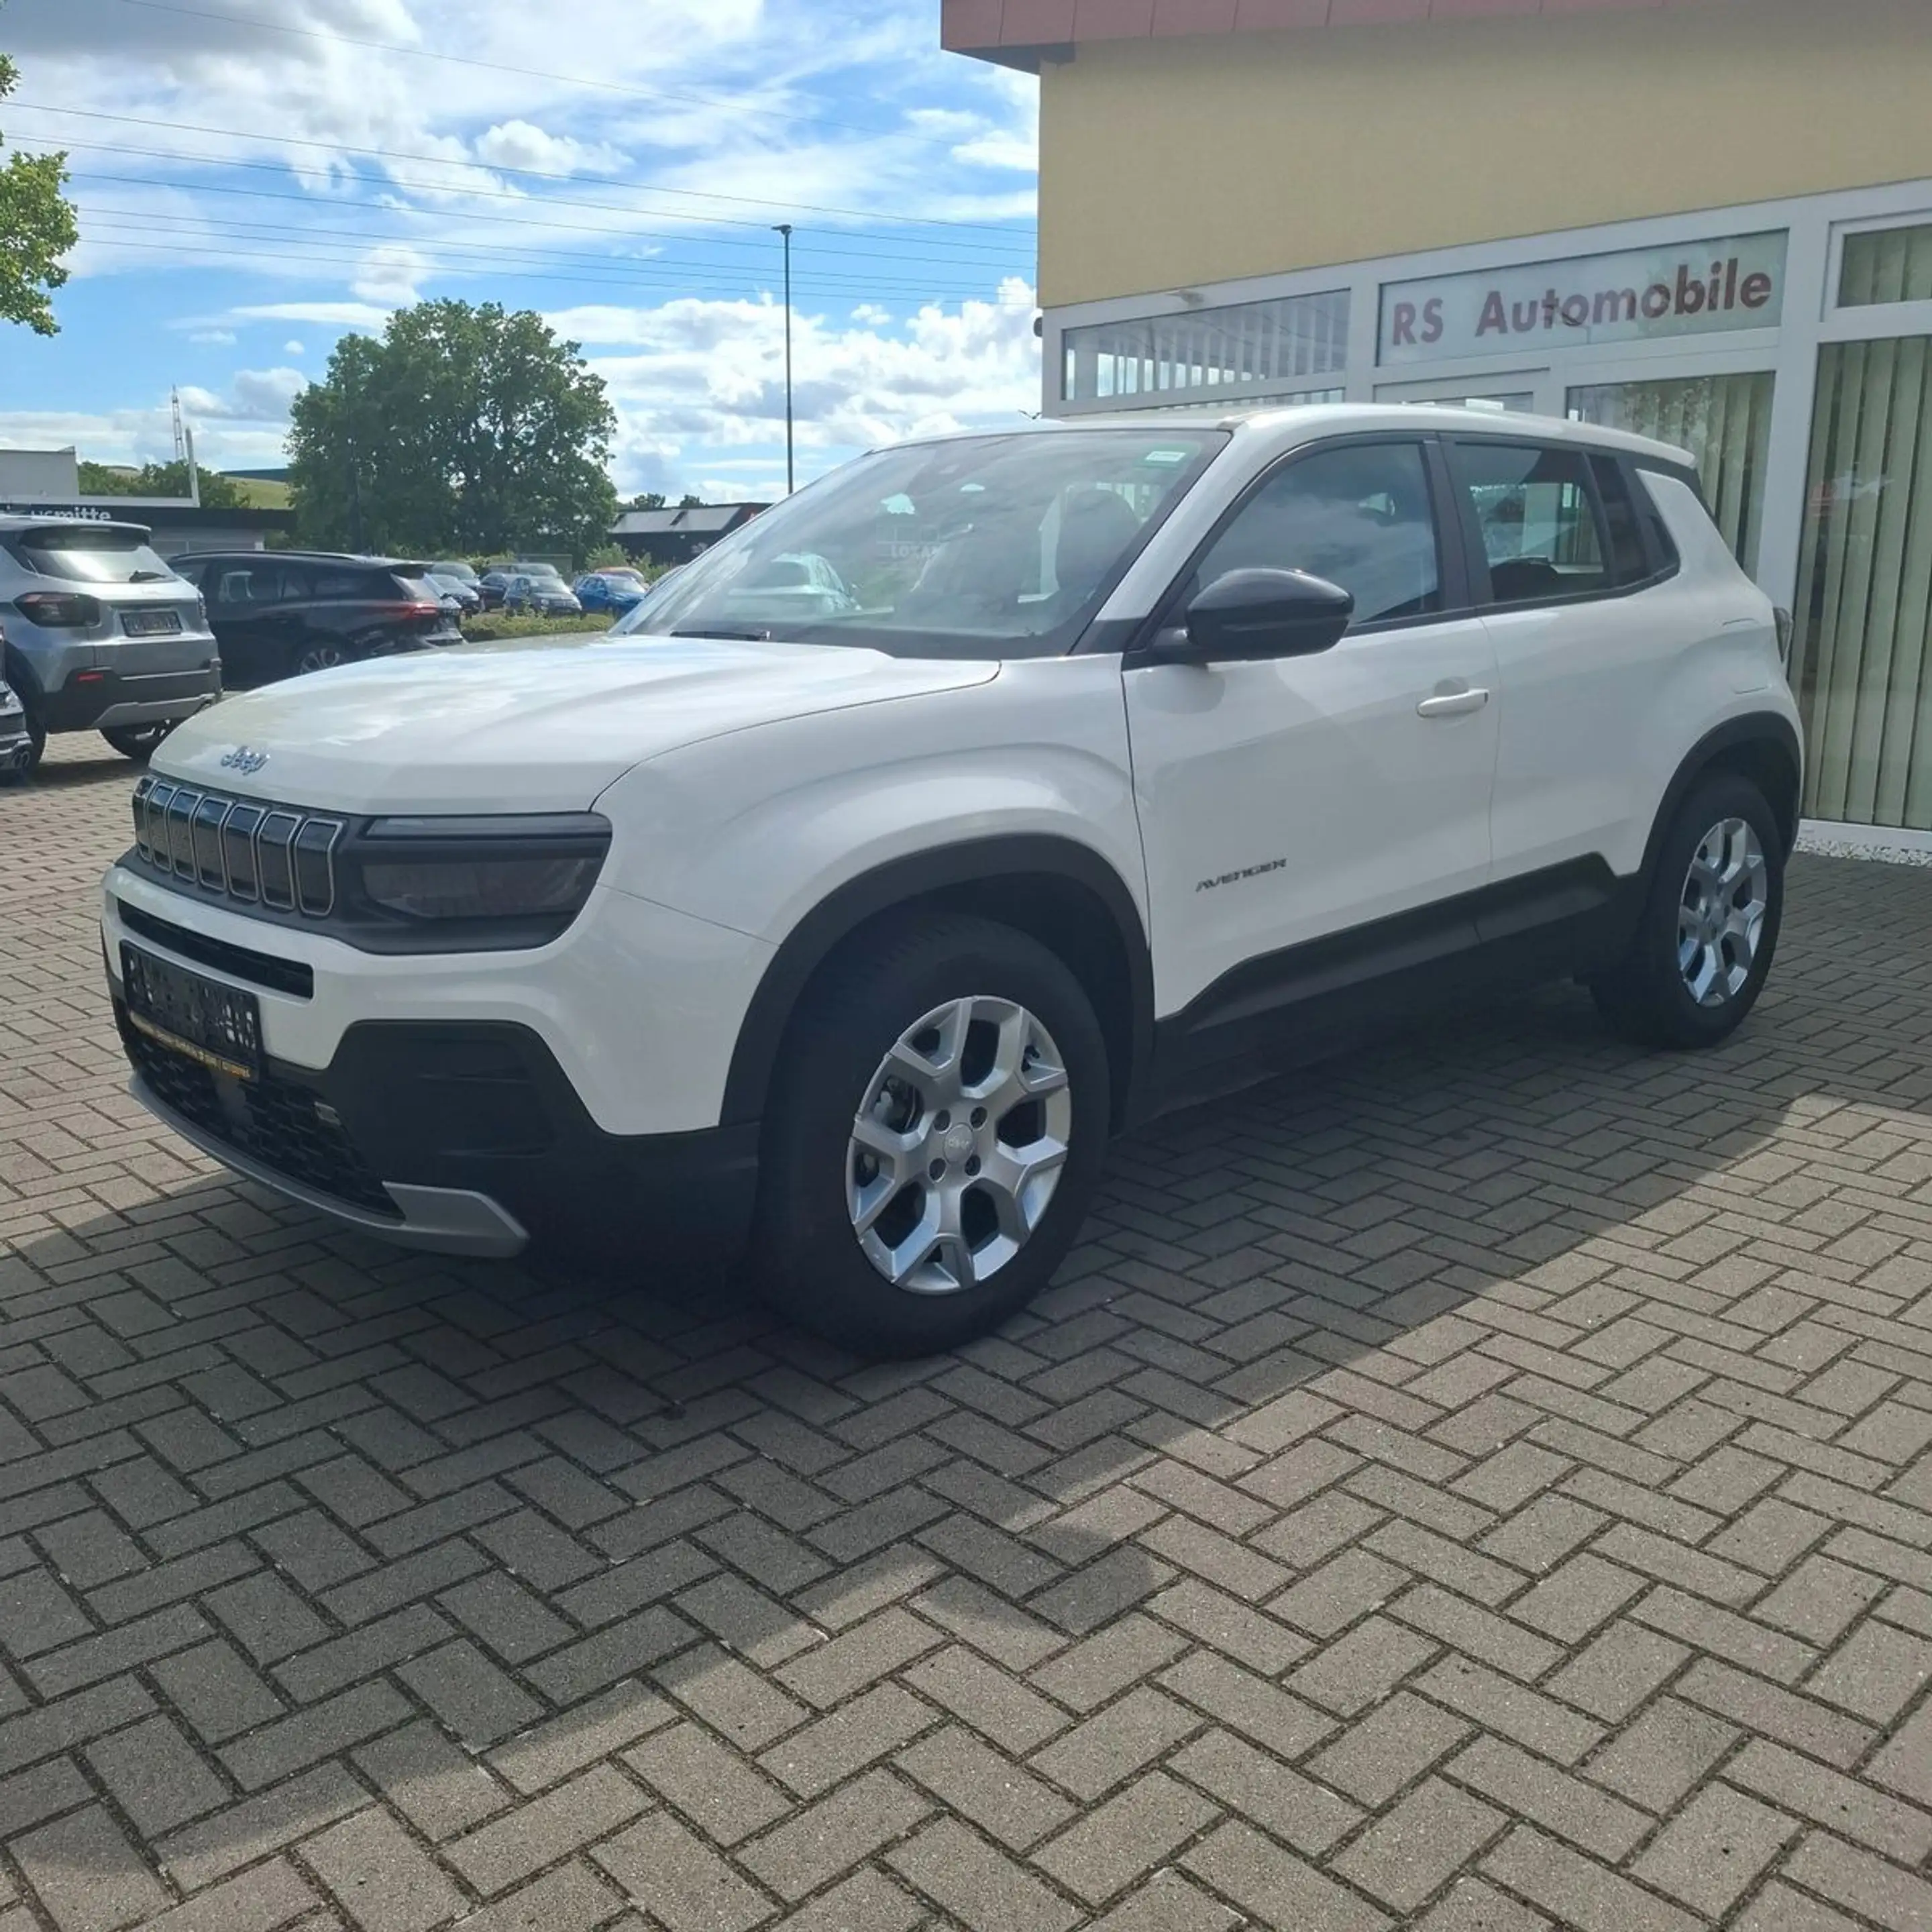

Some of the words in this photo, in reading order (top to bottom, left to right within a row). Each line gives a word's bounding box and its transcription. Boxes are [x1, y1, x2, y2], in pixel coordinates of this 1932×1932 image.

[1392, 297, 1444, 346] RS
[1475, 258, 1772, 337] Automobile
[220, 745, 270, 777] Jeep
[1195, 858, 1287, 893] AVENGER
